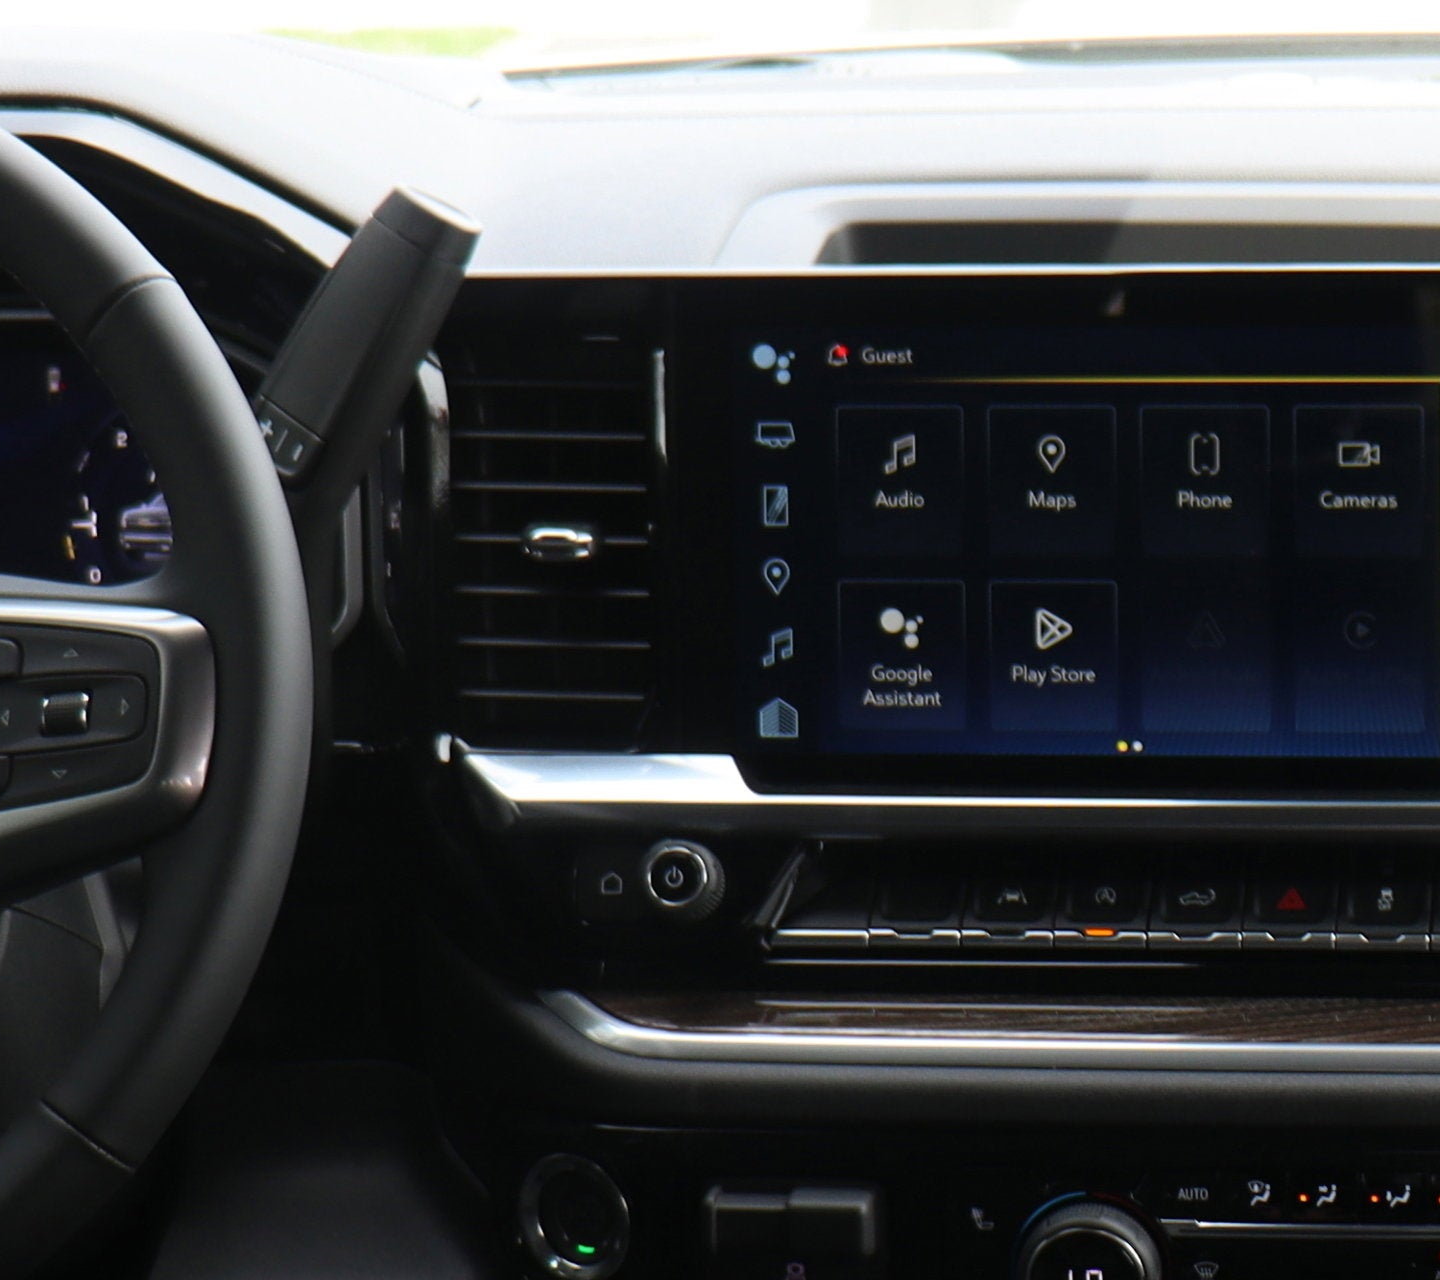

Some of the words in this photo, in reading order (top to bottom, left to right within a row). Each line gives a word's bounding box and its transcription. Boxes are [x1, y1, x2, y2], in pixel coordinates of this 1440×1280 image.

[862, 346, 913, 365] Guest
[115, 429, 128, 448] 2
[875, 490, 925, 508] Audio
[1028, 491, 1077, 512] Maps
[1178, 491, 1233, 509] Phone
[1320, 491, 1398, 509] Cameras
[871, 665, 933, 687] Google
[1012, 665, 1047, 687] Play
[1051, 666, 1096, 684] Store
[863, 689, 941, 708] Assistant
[1178, 1188, 1209, 1201] AUTO
